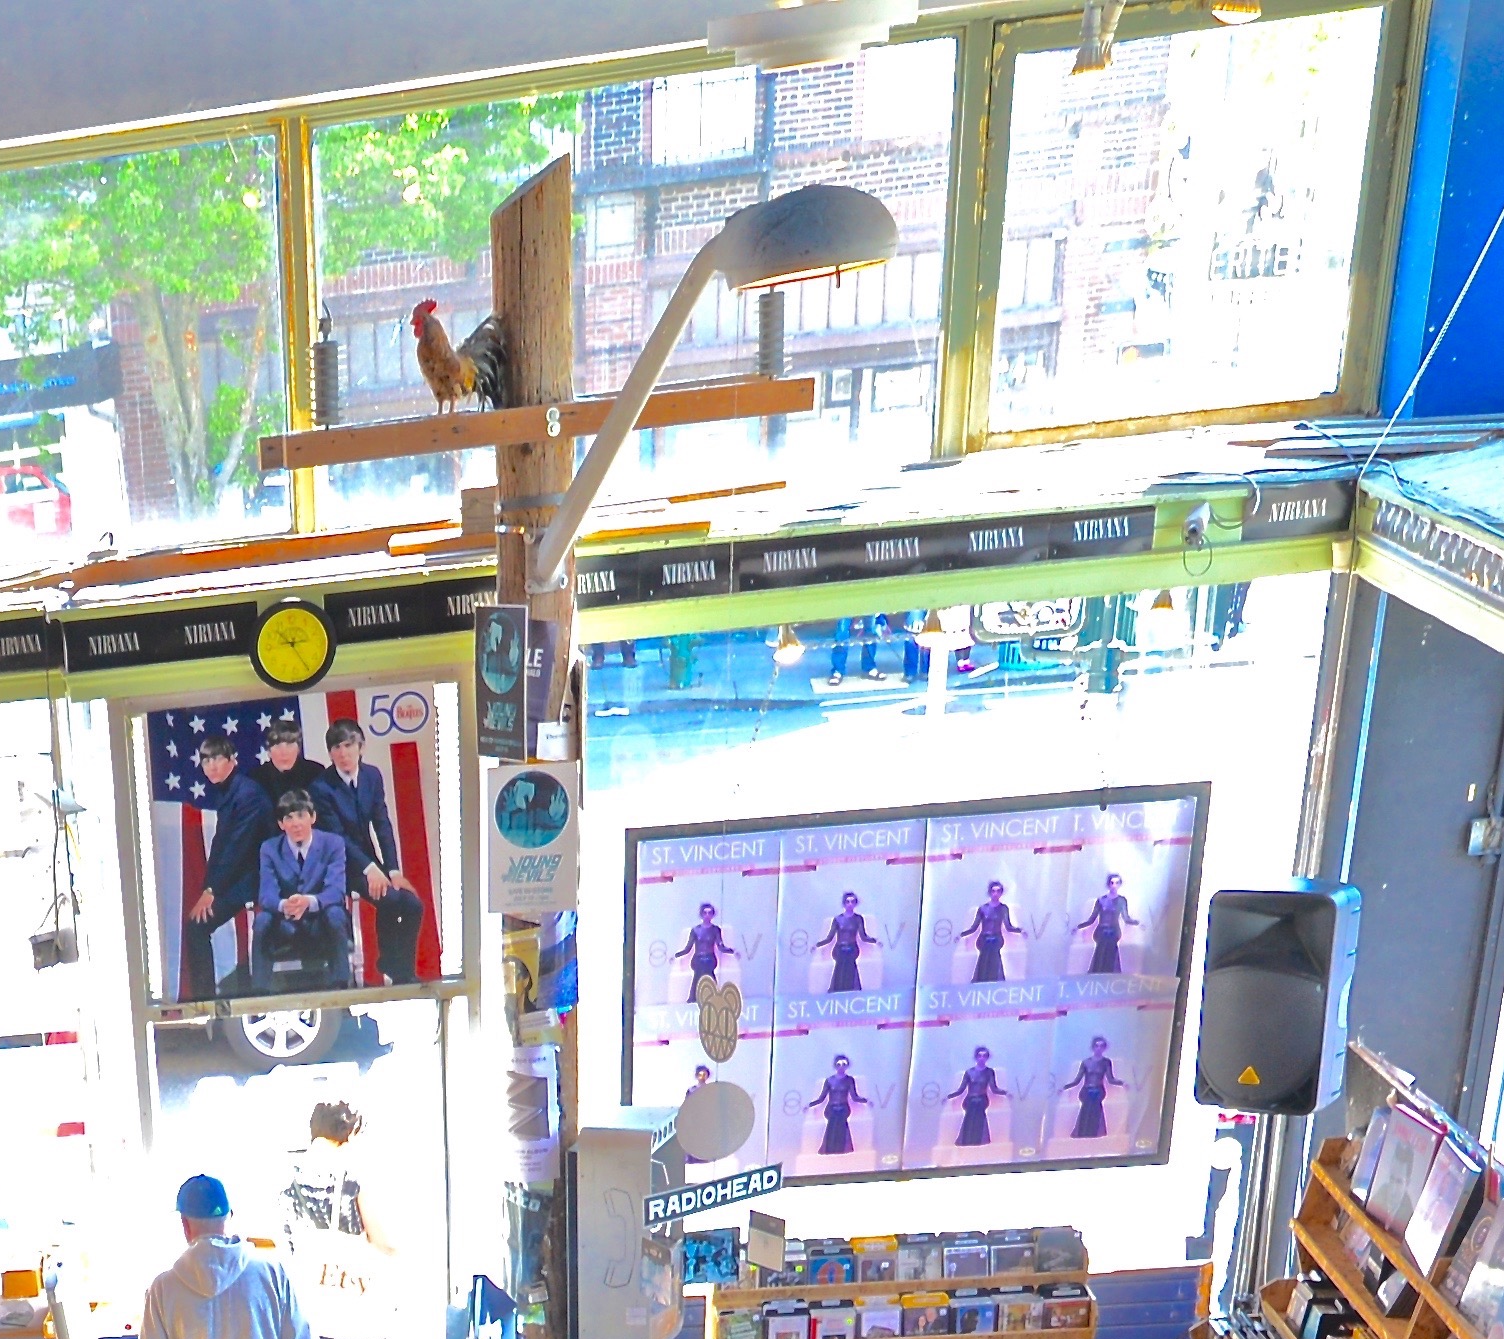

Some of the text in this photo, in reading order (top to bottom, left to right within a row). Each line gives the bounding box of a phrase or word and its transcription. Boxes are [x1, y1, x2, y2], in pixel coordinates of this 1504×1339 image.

[1267, 498, 1328, 524] NIRVANA
[968, 529, 1025, 553] NIRVANA
[1071, 517, 1131, 543] NIRVANA
[763, 547, 818, 573] NIRVANA
[864, 537, 921, 563] NIRVANA
[576, 568, 616, 594] RVANA
[661, 560, 716, 586] NIRVANA
[347, 602, 400, 627] NIRVANA
[88, 631, 141, 656] NIRVANA
[183, 620, 236, 646] NIRVANA
[368, 691, 429, 736] 50
[795, 827, 912, 854] ST. VINCENT
[941, 816, 1060, 842] ST. VINCENT
[652, 839, 766, 865] ST. VINCENT
[929, 986, 1044, 1011] ST. VINCENT
[1077, 975, 1163, 998] VINCENT
[788, 995, 902, 1020] ST. VINCENT
[648, 1170, 778, 1219] RADIOHEAD
